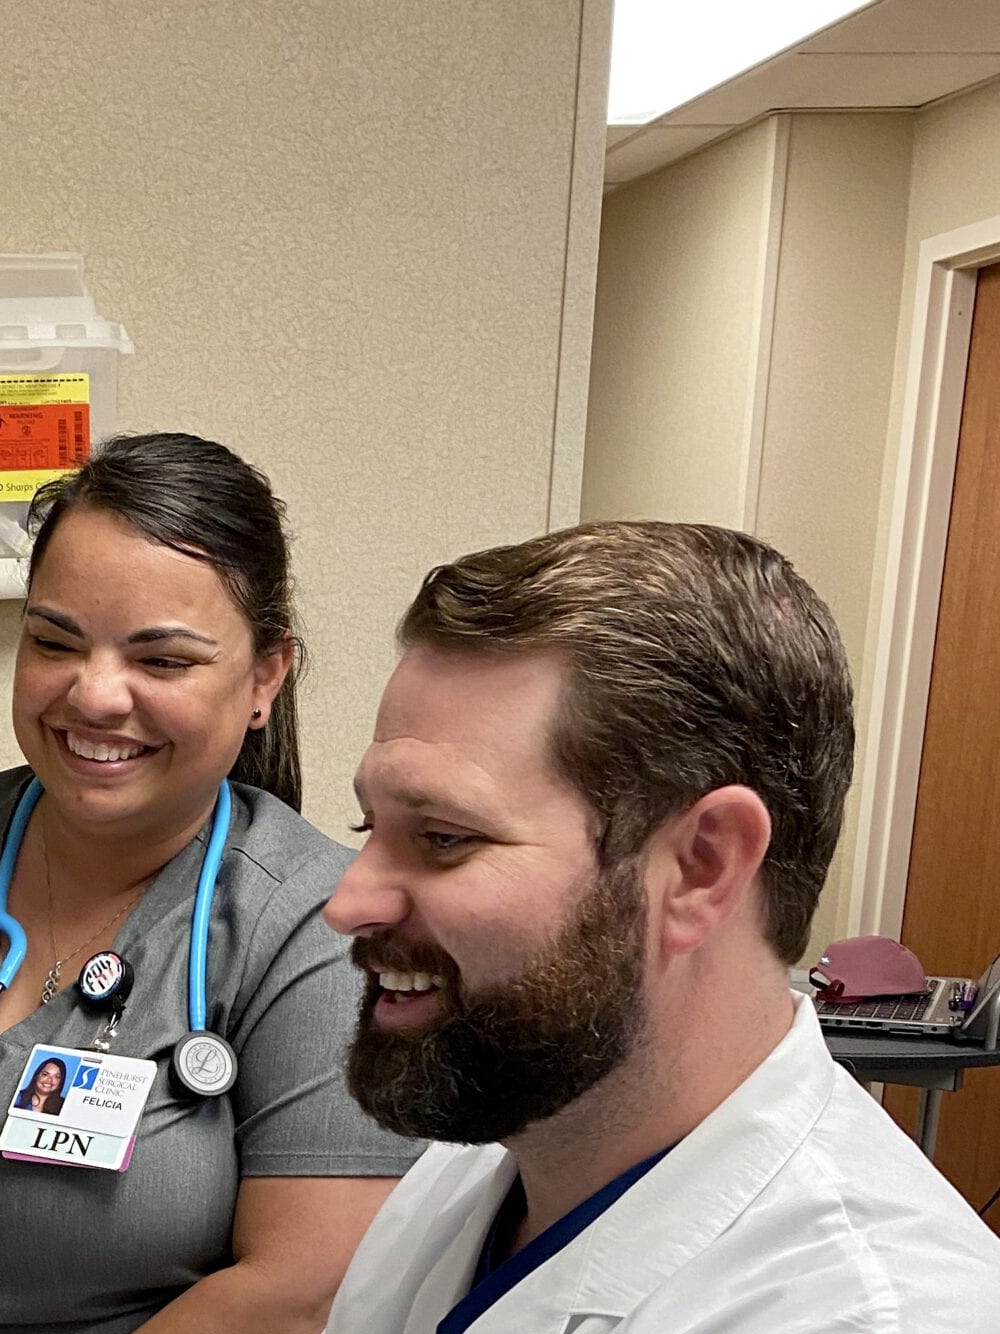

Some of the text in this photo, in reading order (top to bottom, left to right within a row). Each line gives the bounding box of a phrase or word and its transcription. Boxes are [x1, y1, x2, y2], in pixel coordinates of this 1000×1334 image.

[6, 482, 34, 494] Sharps
[101, 1069, 148, 1084] PINEHURST
[98, 1077, 136, 1091] SURGICAL
[94, 1086, 125, 1098] CLINIC
[82, 1095, 122, 1111] FELICIA
[30, 1127, 95, 1158] LPN
